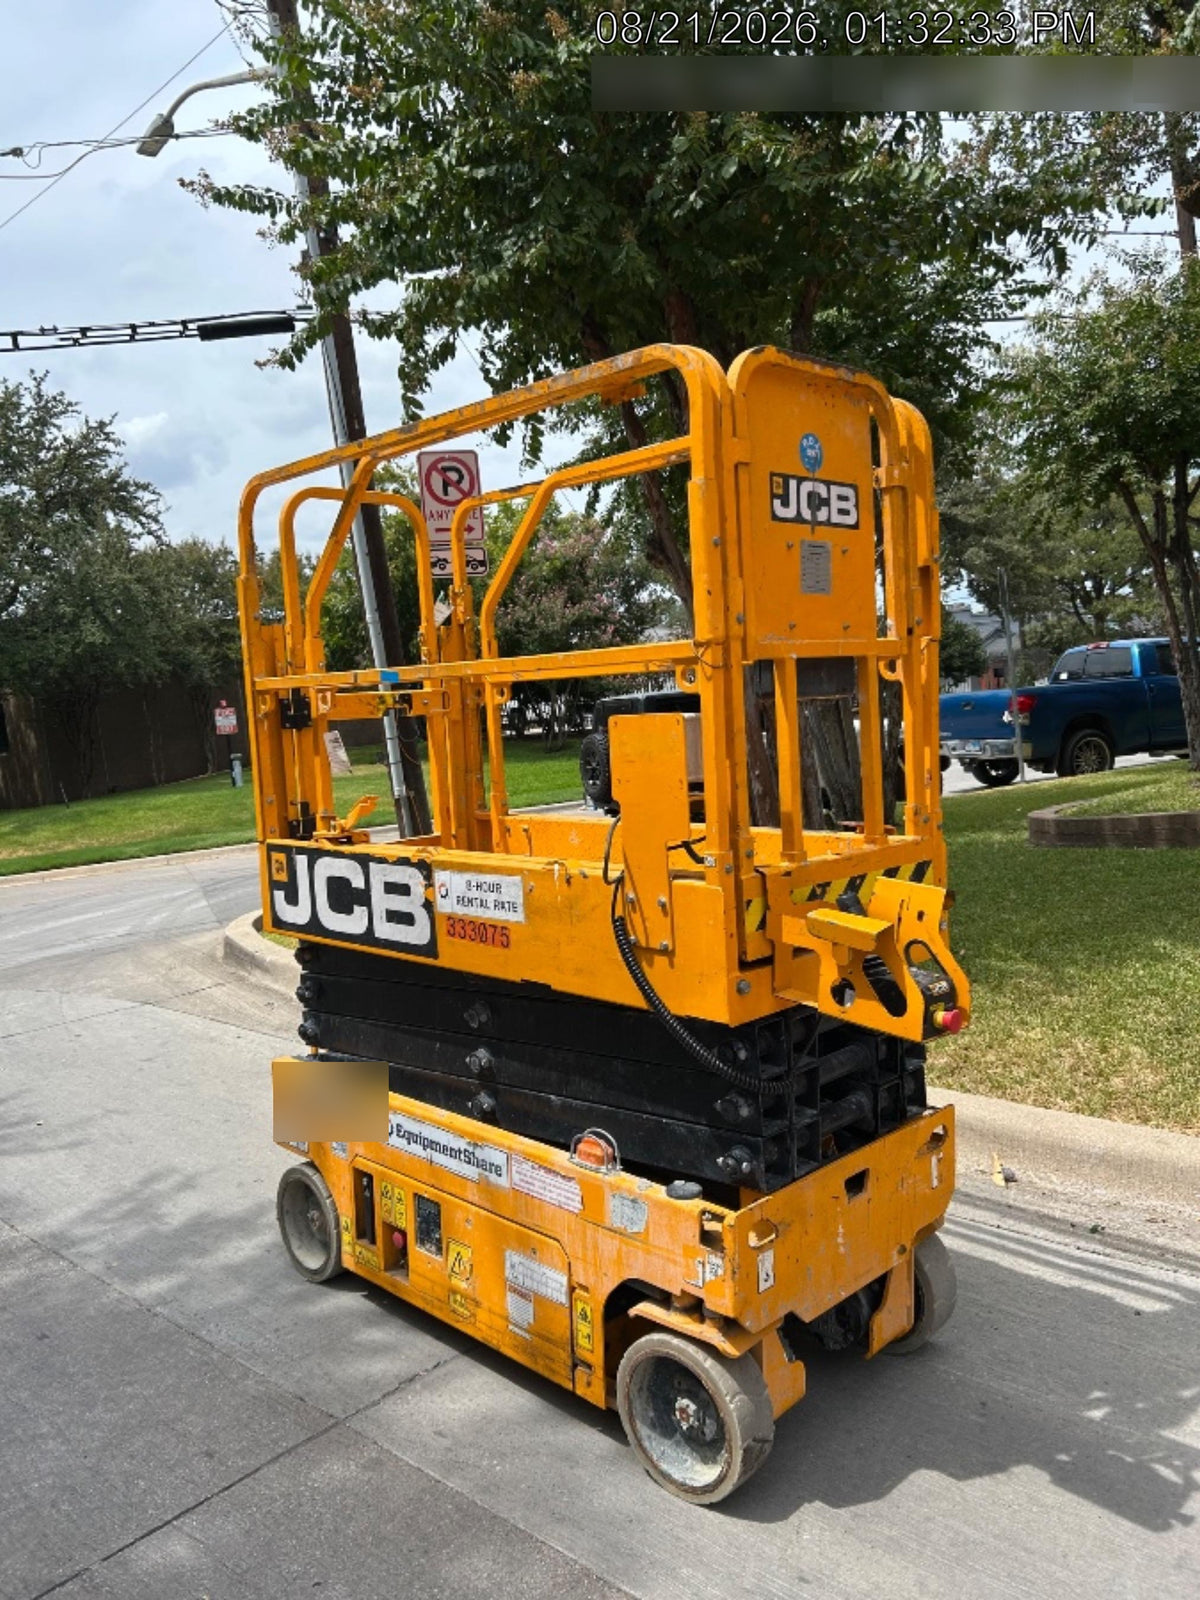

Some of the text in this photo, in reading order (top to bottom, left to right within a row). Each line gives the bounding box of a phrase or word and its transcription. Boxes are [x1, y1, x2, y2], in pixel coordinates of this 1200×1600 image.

[773, 477, 858, 526] JCB
[273, 854, 431, 945] JCB
[456, 895, 518, 913] RENTAL RATE
[447, 916, 511, 949] 333075
[395, 1122, 502, 1178] EquipmentShare
